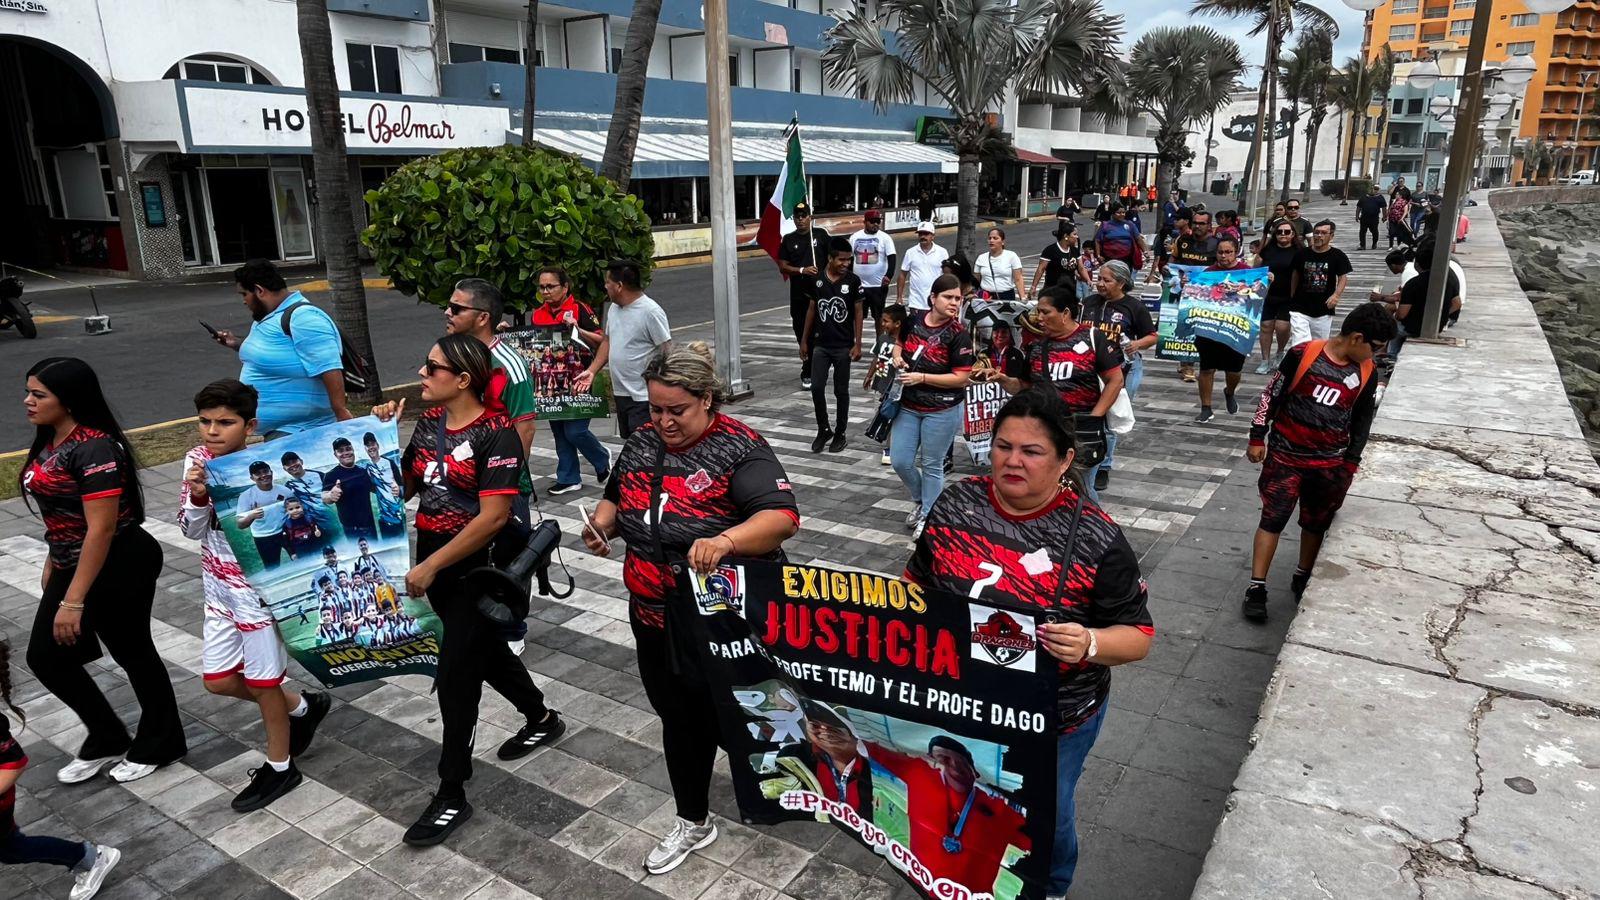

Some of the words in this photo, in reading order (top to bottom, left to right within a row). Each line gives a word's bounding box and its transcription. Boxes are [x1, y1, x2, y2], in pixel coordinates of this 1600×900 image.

[262, 108, 365, 133] HOL
[368, 103, 455, 143] Belmar
[1189, 307, 1251, 331] INOCENTES
[1048, 361, 1074, 381] 40
[562, 394, 574, 402] las
[1312, 384, 1341, 406] 40
[541, 404, 563, 413] Temo
[967, 404, 981, 422] EL
[782, 566, 928, 613] EXIGIMOS
[968, 561, 1003, 599] 7
[762, 601, 960, 681] JUSTICIA
[329, 659, 397, 676] QUEREMS
[398, 654, 438, 668] JUSTIC
[709, 638, 755, 659] PARA
[773, 655, 823, 683] PROFE
[828, 667, 876, 696] TEMO
[882, 677, 893, 699] Y
[899, 680, 920, 707] EL
[926, 688, 983, 722] PROFE
[990, 704, 1045, 734] DAGO
[784, 793, 860, 827] #Profe
[863, 823, 887, 846] yo
[891, 844, 930, 887] creo
